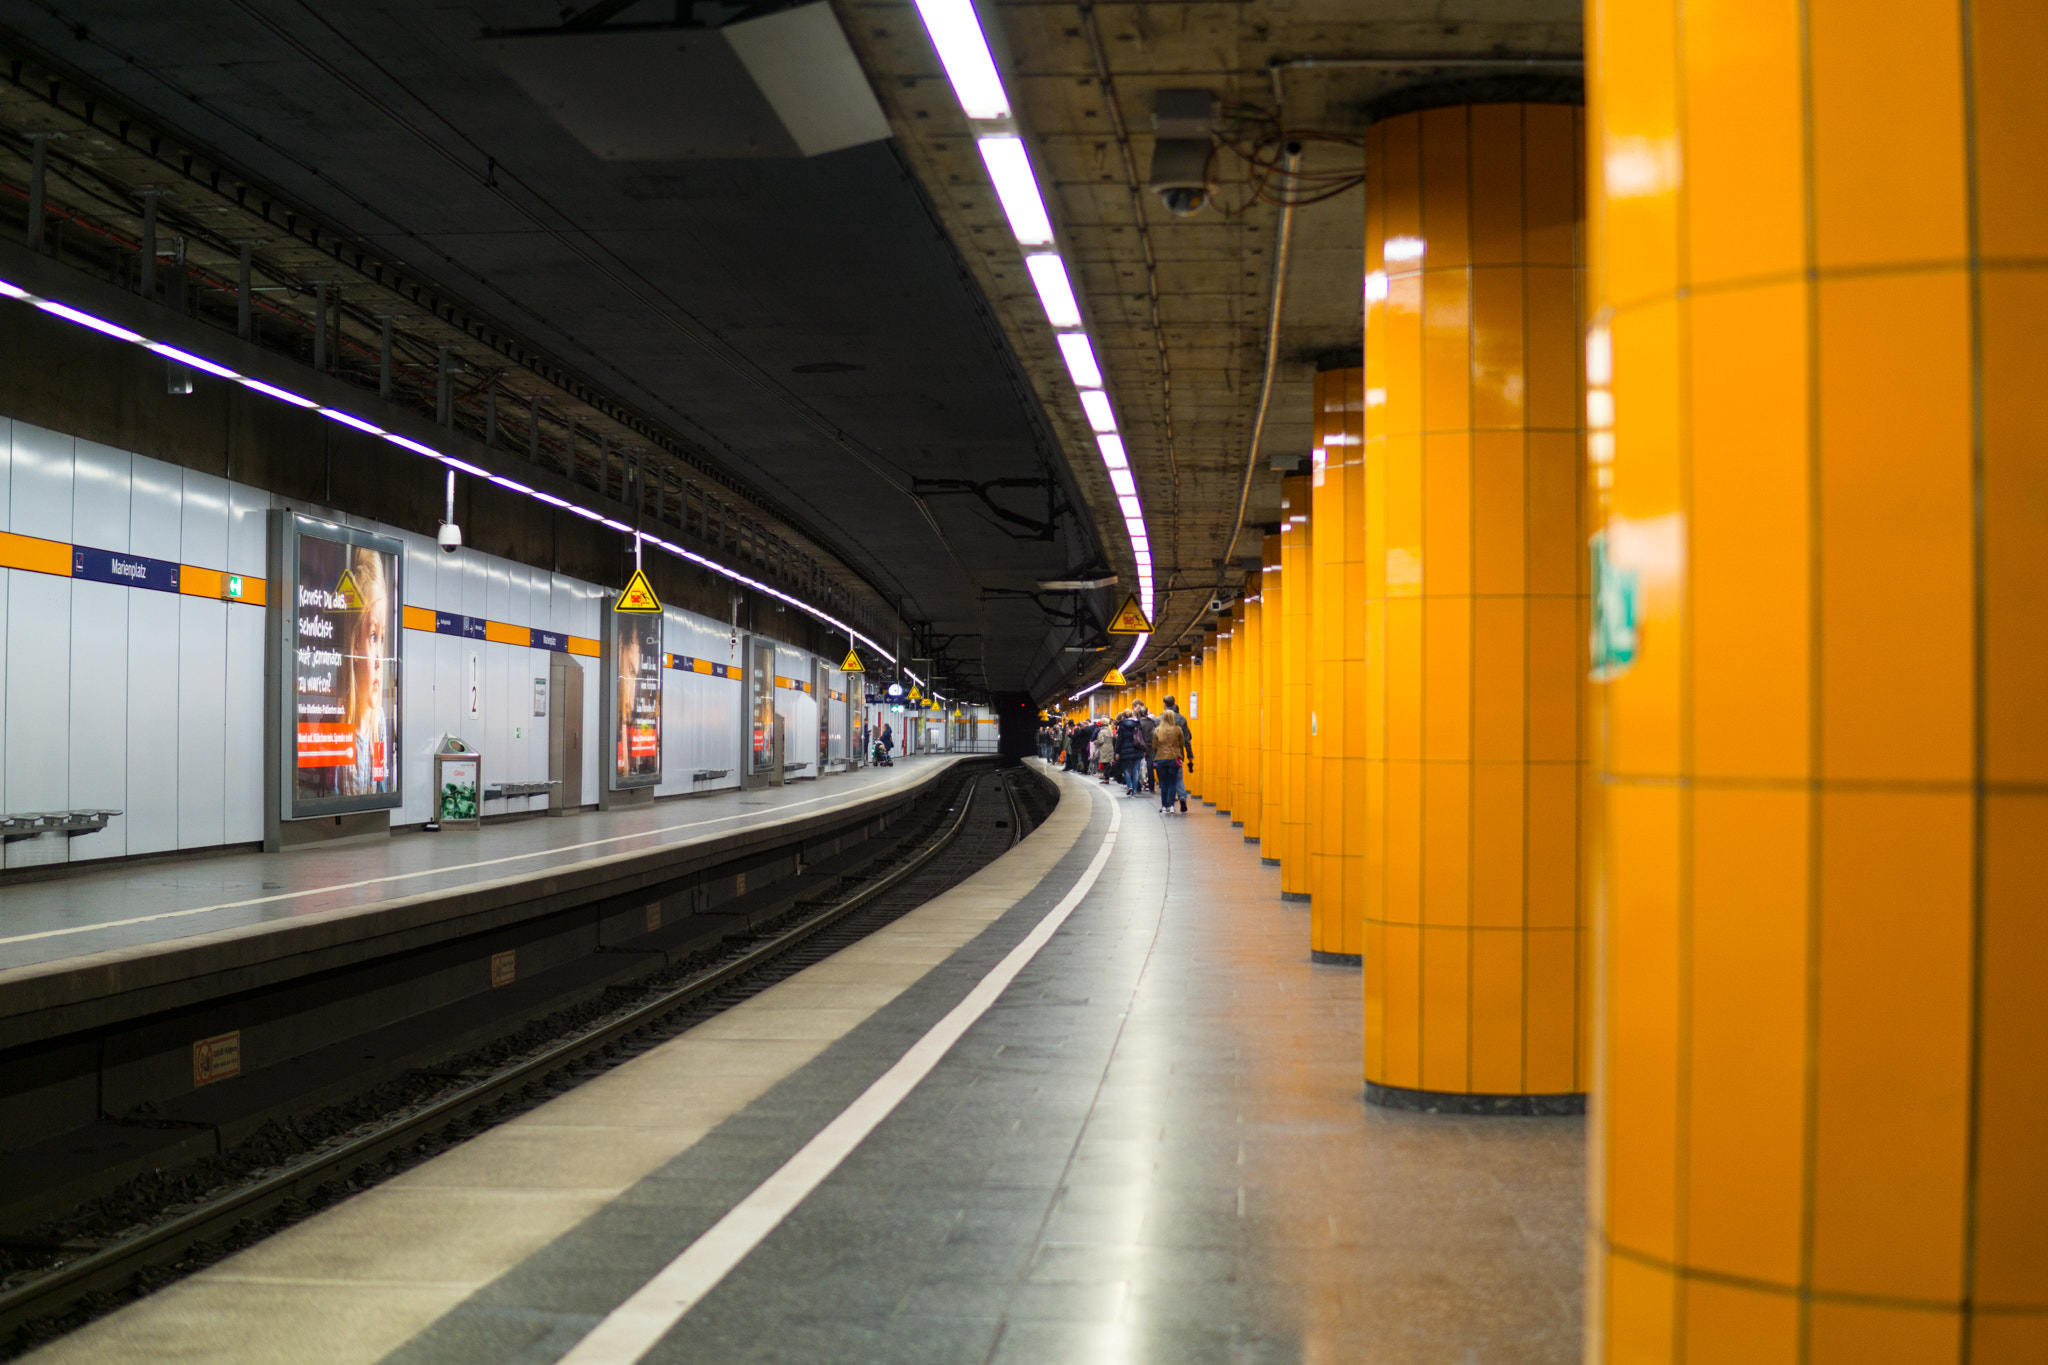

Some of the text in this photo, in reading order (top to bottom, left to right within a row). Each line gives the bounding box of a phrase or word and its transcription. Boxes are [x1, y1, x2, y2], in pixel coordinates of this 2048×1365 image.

[112, 558, 146, 580] Marienplatz
[299, 585, 323, 608] Kennst
[323, 590, 333, 609] Du
[299, 615, 333, 639] sehnlichst
[312, 646, 342, 668] jemanden
[307, 672, 331, 693] warten?
[471, 685, 477, 713] 2
